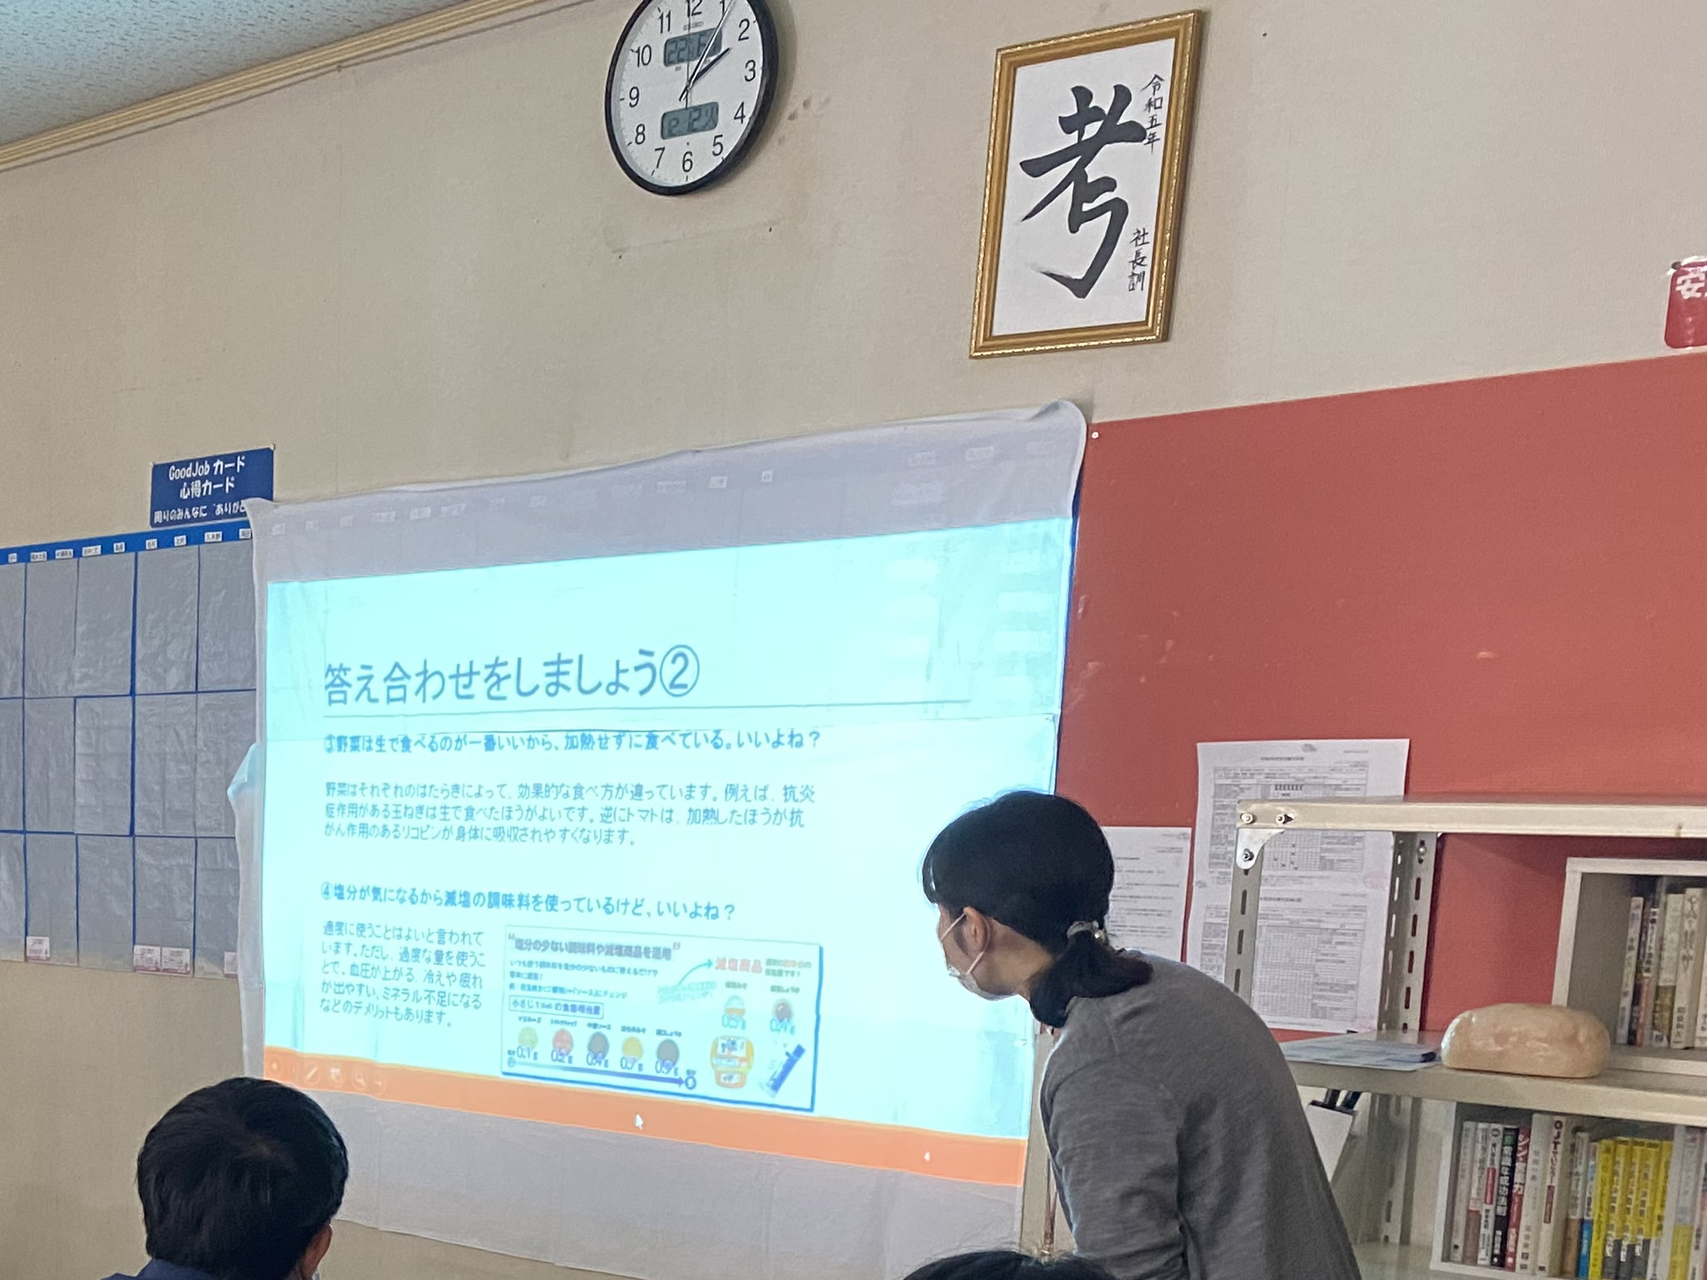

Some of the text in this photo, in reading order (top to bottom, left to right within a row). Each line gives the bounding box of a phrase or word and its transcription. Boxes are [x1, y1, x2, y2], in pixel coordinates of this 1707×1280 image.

[659, 10, 671, 33] 11
[738, 18, 750, 41] 2
[636, 44, 652, 67] 10
[744, 59, 756, 82] 3
[628, 86, 640, 108] 9
[733, 102, 746, 124] 4
[1142, 74, 1166, 154] 令和五年
[634, 124, 646, 145] 8
[712, 135, 724, 156] 5
[655, 147, 665, 168] 7
[682, 151, 693, 172] 6
[1019, 84, 1147, 299] 考
[1128, 227, 1150, 292] 社長訓
[1675, 268, 1707, 299] 安
[168, 455, 245, 481] GoodJob カード
[179, 476, 235, 499] 心得カード
[324, 643, 700, 706] 答え合わせをしましょう②
[320, 998, 452, 1028] などのデメリットもあります。
